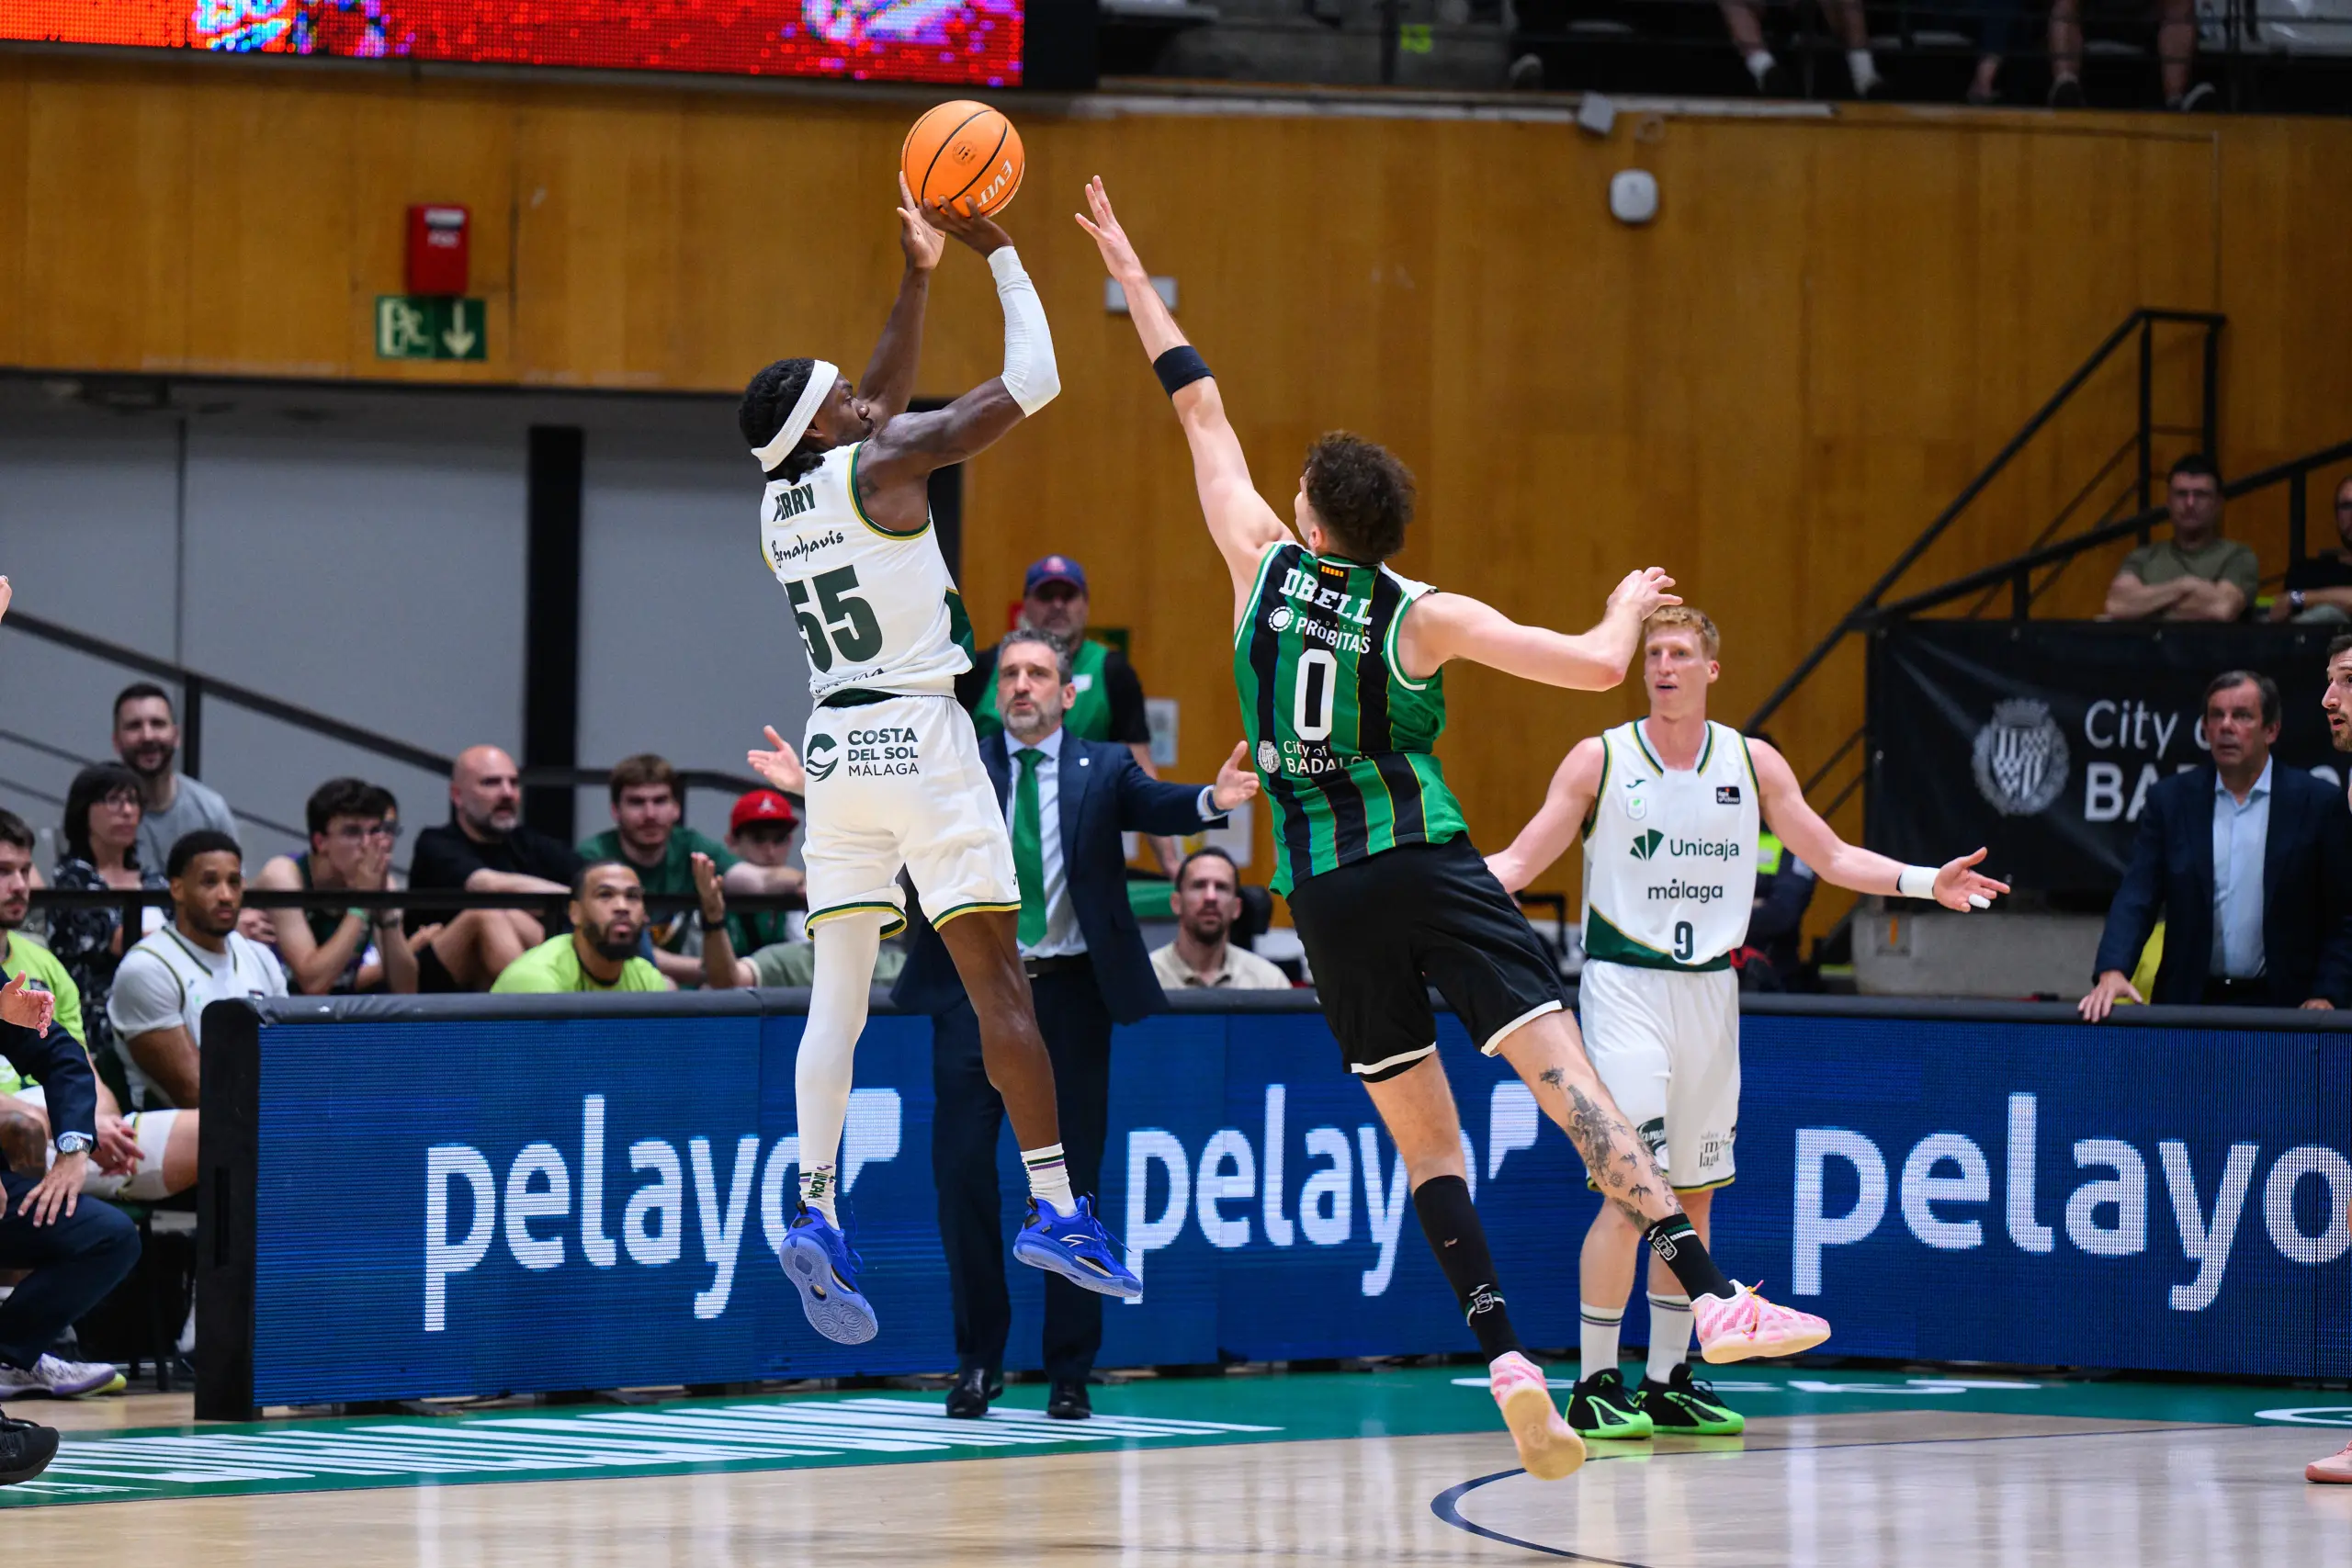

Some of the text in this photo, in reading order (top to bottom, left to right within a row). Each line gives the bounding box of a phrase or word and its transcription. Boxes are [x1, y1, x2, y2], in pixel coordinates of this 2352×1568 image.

[773, 482, 816, 523] RRY
[784, 564, 883, 673] 55
[1295, 616, 1372, 654] PROBITAS
[1294, 648, 1338, 741] 0
[847, 727, 919, 746] COSTA
[1283, 740, 1328, 758] City of
[2084, 699, 2178, 760] City
[847, 746, 919, 761] DEL SOL
[848, 761, 920, 777] MÁLAGA
[1669, 838, 1739, 862] Unicaja
[1674, 920, 1693, 961] 9
[1125, 1083, 1477, 1304] pelay
[1792, 1091, 2352, 1312] pelayo
